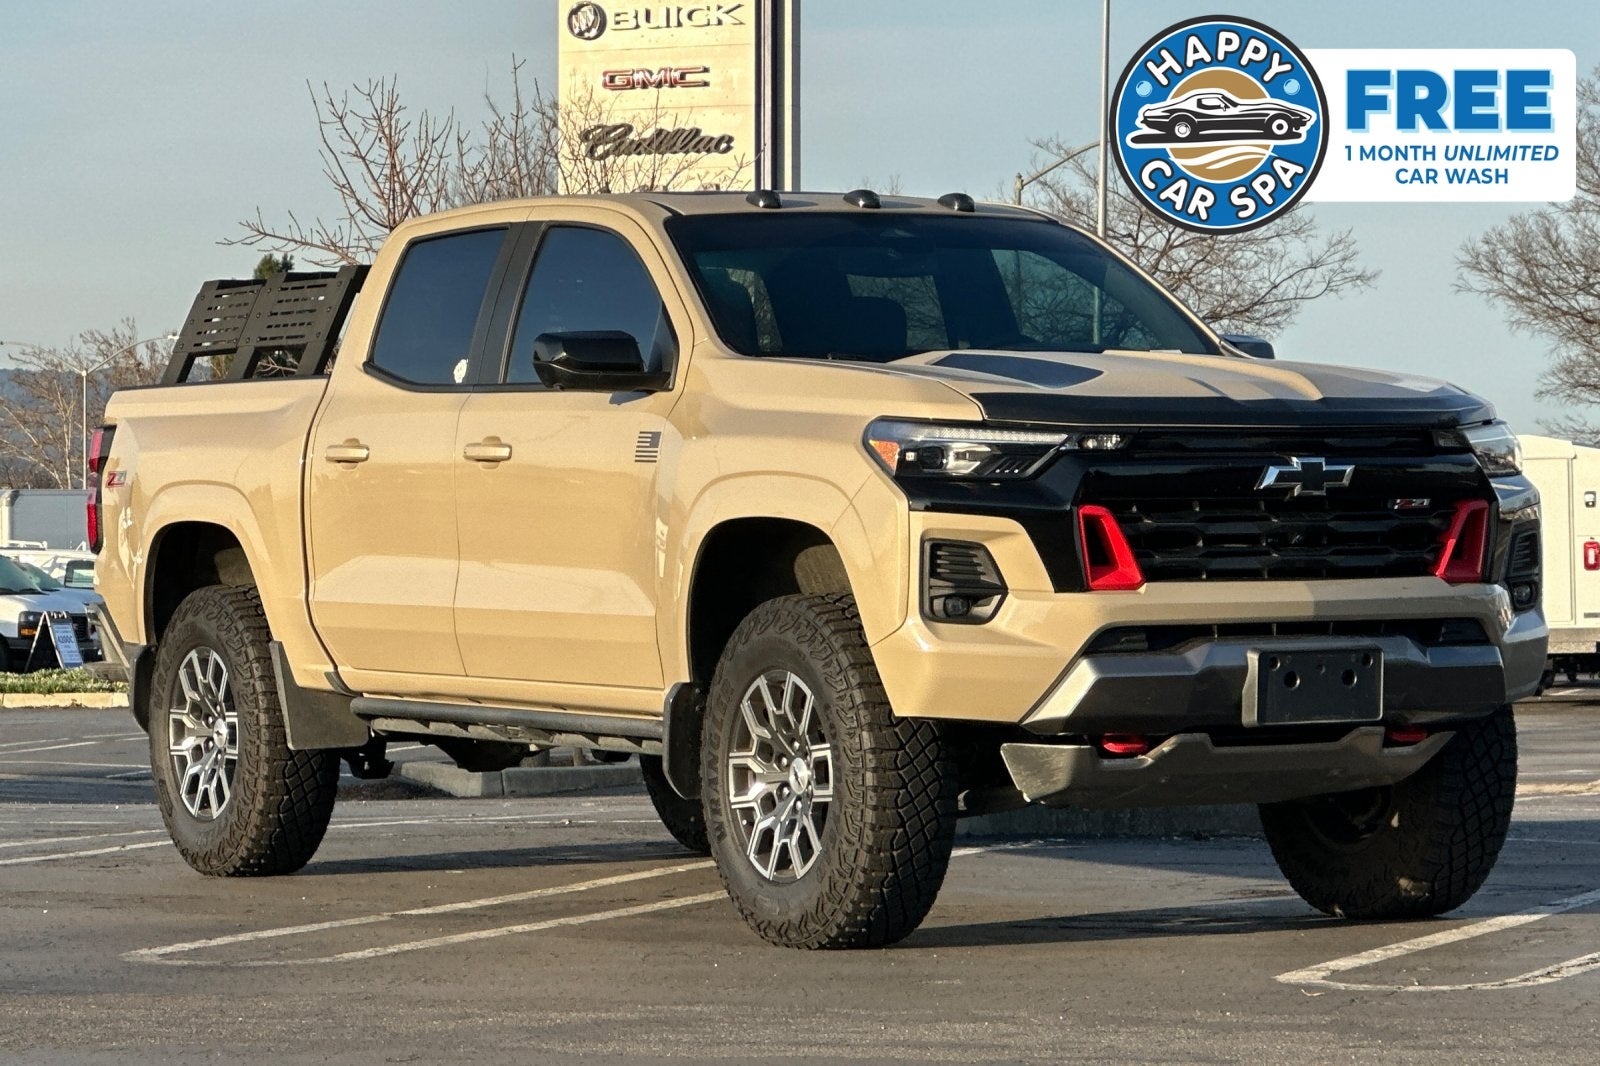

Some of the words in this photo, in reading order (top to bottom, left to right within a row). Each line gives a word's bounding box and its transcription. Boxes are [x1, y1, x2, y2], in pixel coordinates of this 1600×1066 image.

[611, 3, 746, 31] BUICK
[602, 66, 710, 91] GMC
[580, 123, 735, 160] Cadillac
